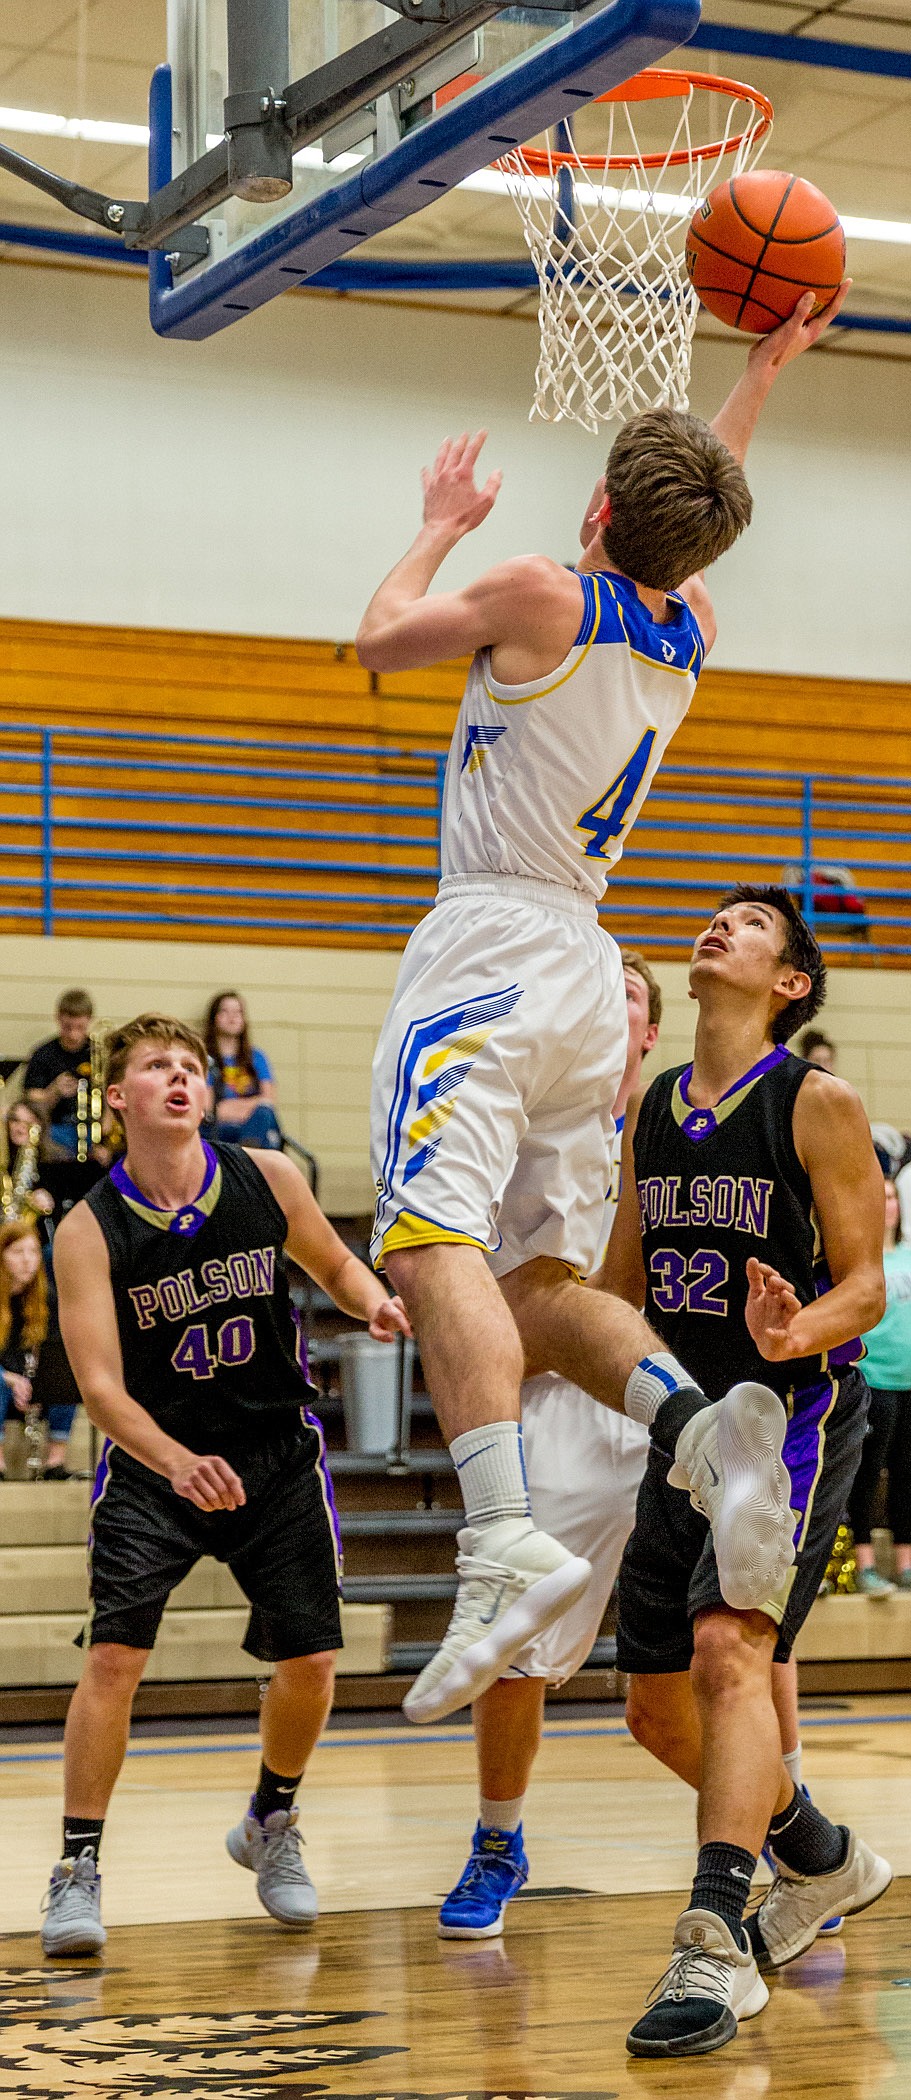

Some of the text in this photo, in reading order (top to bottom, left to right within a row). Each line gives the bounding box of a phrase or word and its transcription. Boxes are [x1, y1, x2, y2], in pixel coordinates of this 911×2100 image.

[574, 726, 658, 863] 4
[691, 1117, 708, 1131] P
[178, 1213, 195, 1230] P
[128, 1246, 276, 1330] POLSON
[650, 1248, 730, 1317] 32
[170, 1314, 256, 1380] 40
